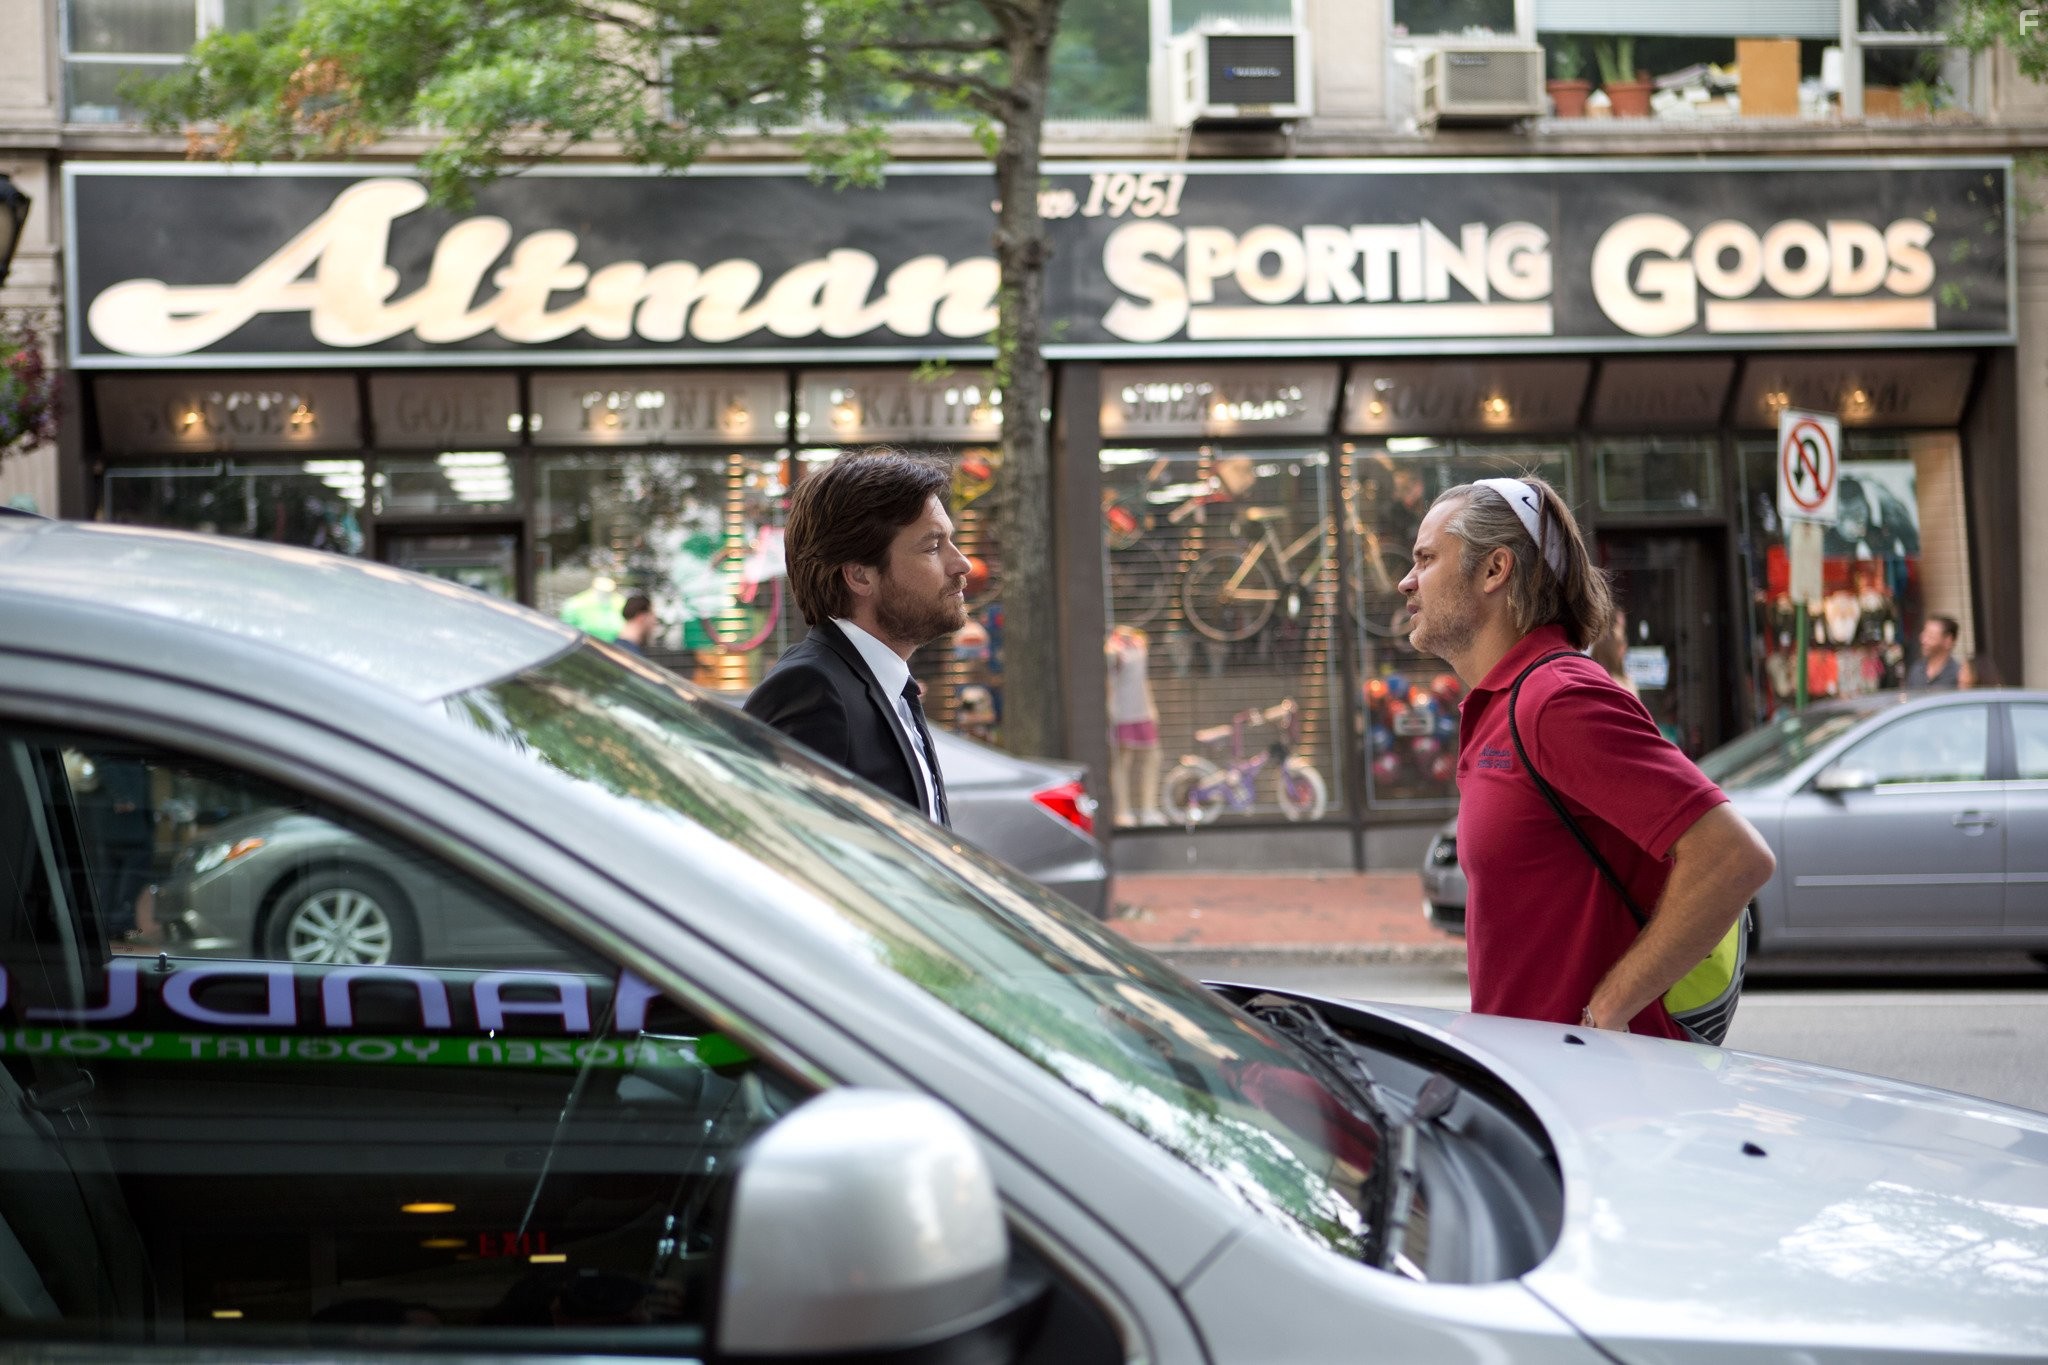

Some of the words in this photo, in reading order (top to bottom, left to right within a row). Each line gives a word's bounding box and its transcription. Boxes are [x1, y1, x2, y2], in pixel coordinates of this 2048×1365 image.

[1081, 173, 1187, 218] 1951
[87, 177, 1002, 357] Altman
[1102, 219, 1553, 343] SPORTING
[1591, 212, 1936, 337] GOODS
